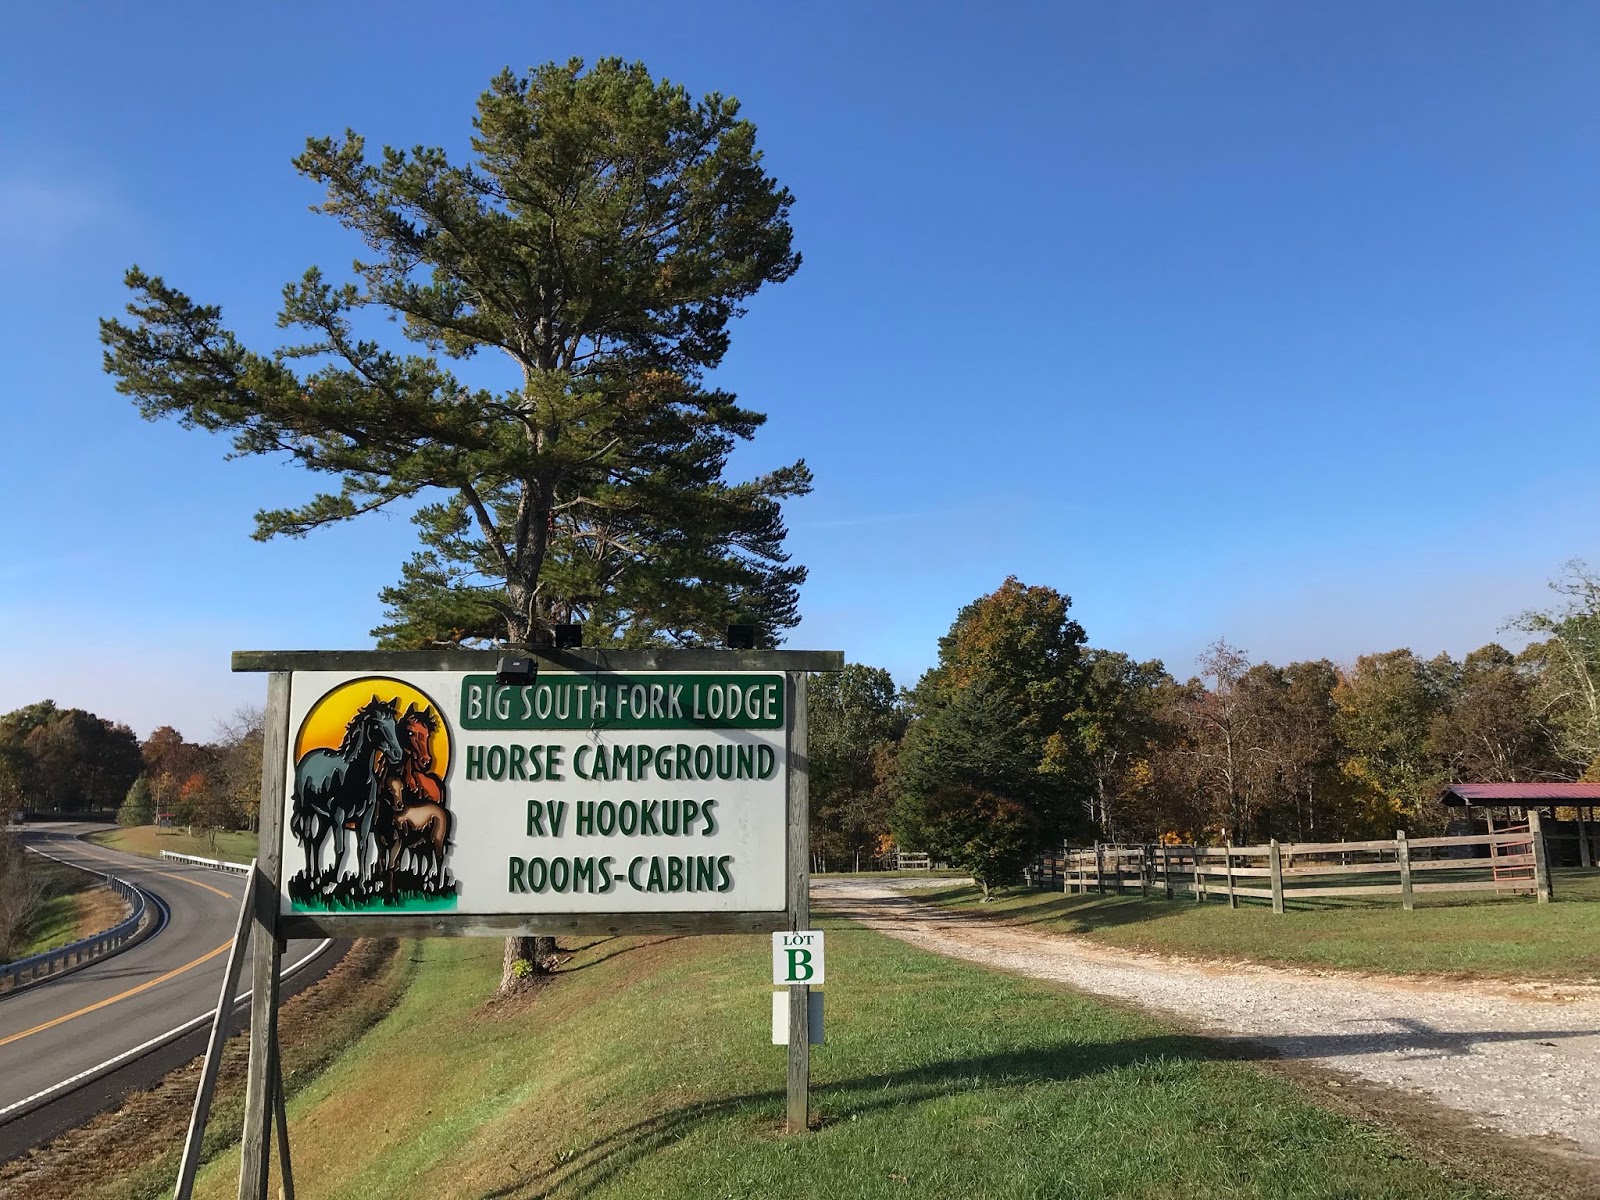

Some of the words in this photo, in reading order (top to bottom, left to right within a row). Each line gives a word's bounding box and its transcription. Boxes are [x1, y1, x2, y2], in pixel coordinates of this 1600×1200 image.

[467, 684, 511, 720] BIG
[521, 684, 606, 720] SOUTH
[616, 683, 684, 719] FORK
[693, 683, 777, 720] LODGE
[466, 744, 562, 781] HORSE
[573, 743, 776, 780] CAMPGROUND
[527, 799, 564, 837] RV
[576, 799, 715, 836] HOOKUPS
[508, 855, 730, 893] ROOMS-CABINS
[783, 935, 814, 946] LOT
[784, 948, 814, 982] B
